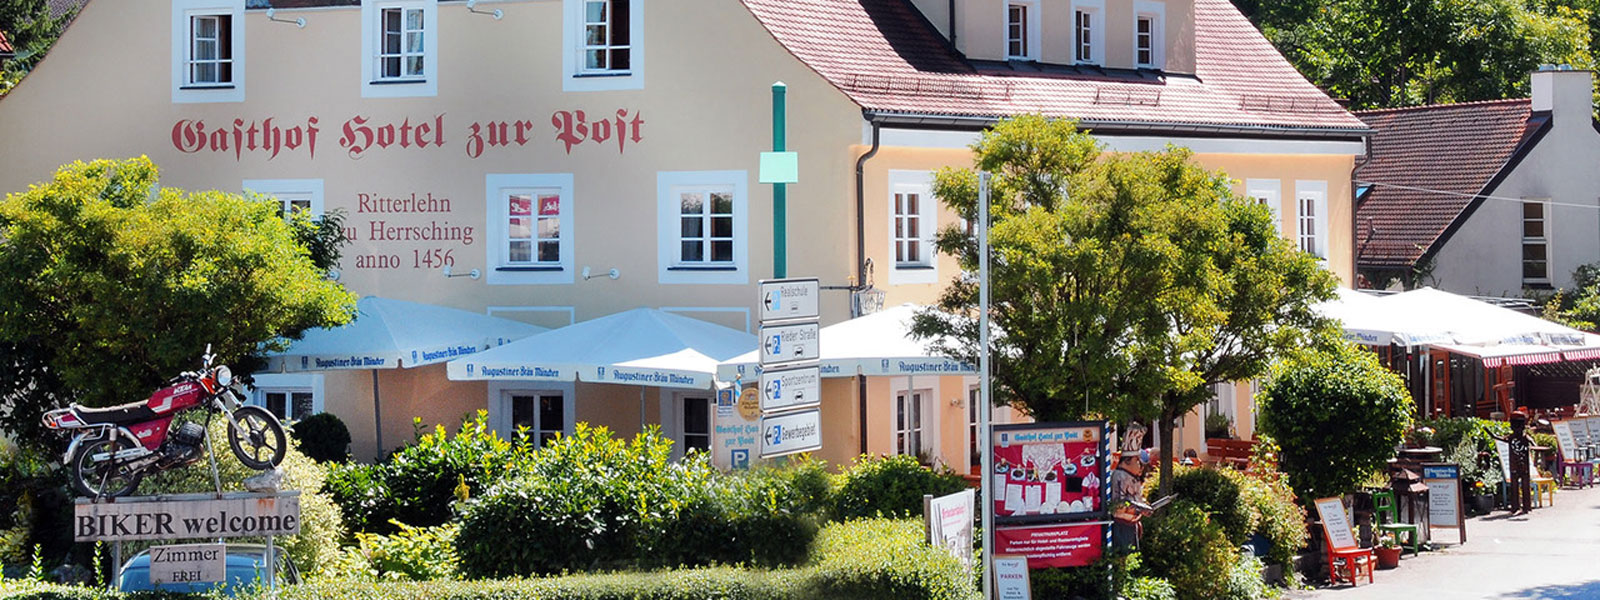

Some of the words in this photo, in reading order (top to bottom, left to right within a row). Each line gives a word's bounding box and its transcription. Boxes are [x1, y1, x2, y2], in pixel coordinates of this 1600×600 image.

[339, 112, 447, 160] Hotel
[466, 119, 533, 159] zur
[357, 193, 452, 213] Ritterlehn
[369, 221, 474, 245] Herrsching
[355, 254, 401, 269] anno
[413, 249, 455, 269] 1456
[77, 513, 175, 537] BIKER
[183, 511, 296, 534] welcome
[153, 547, 219, 563] Zimmer
[172, 571, 201, 582] FREI
